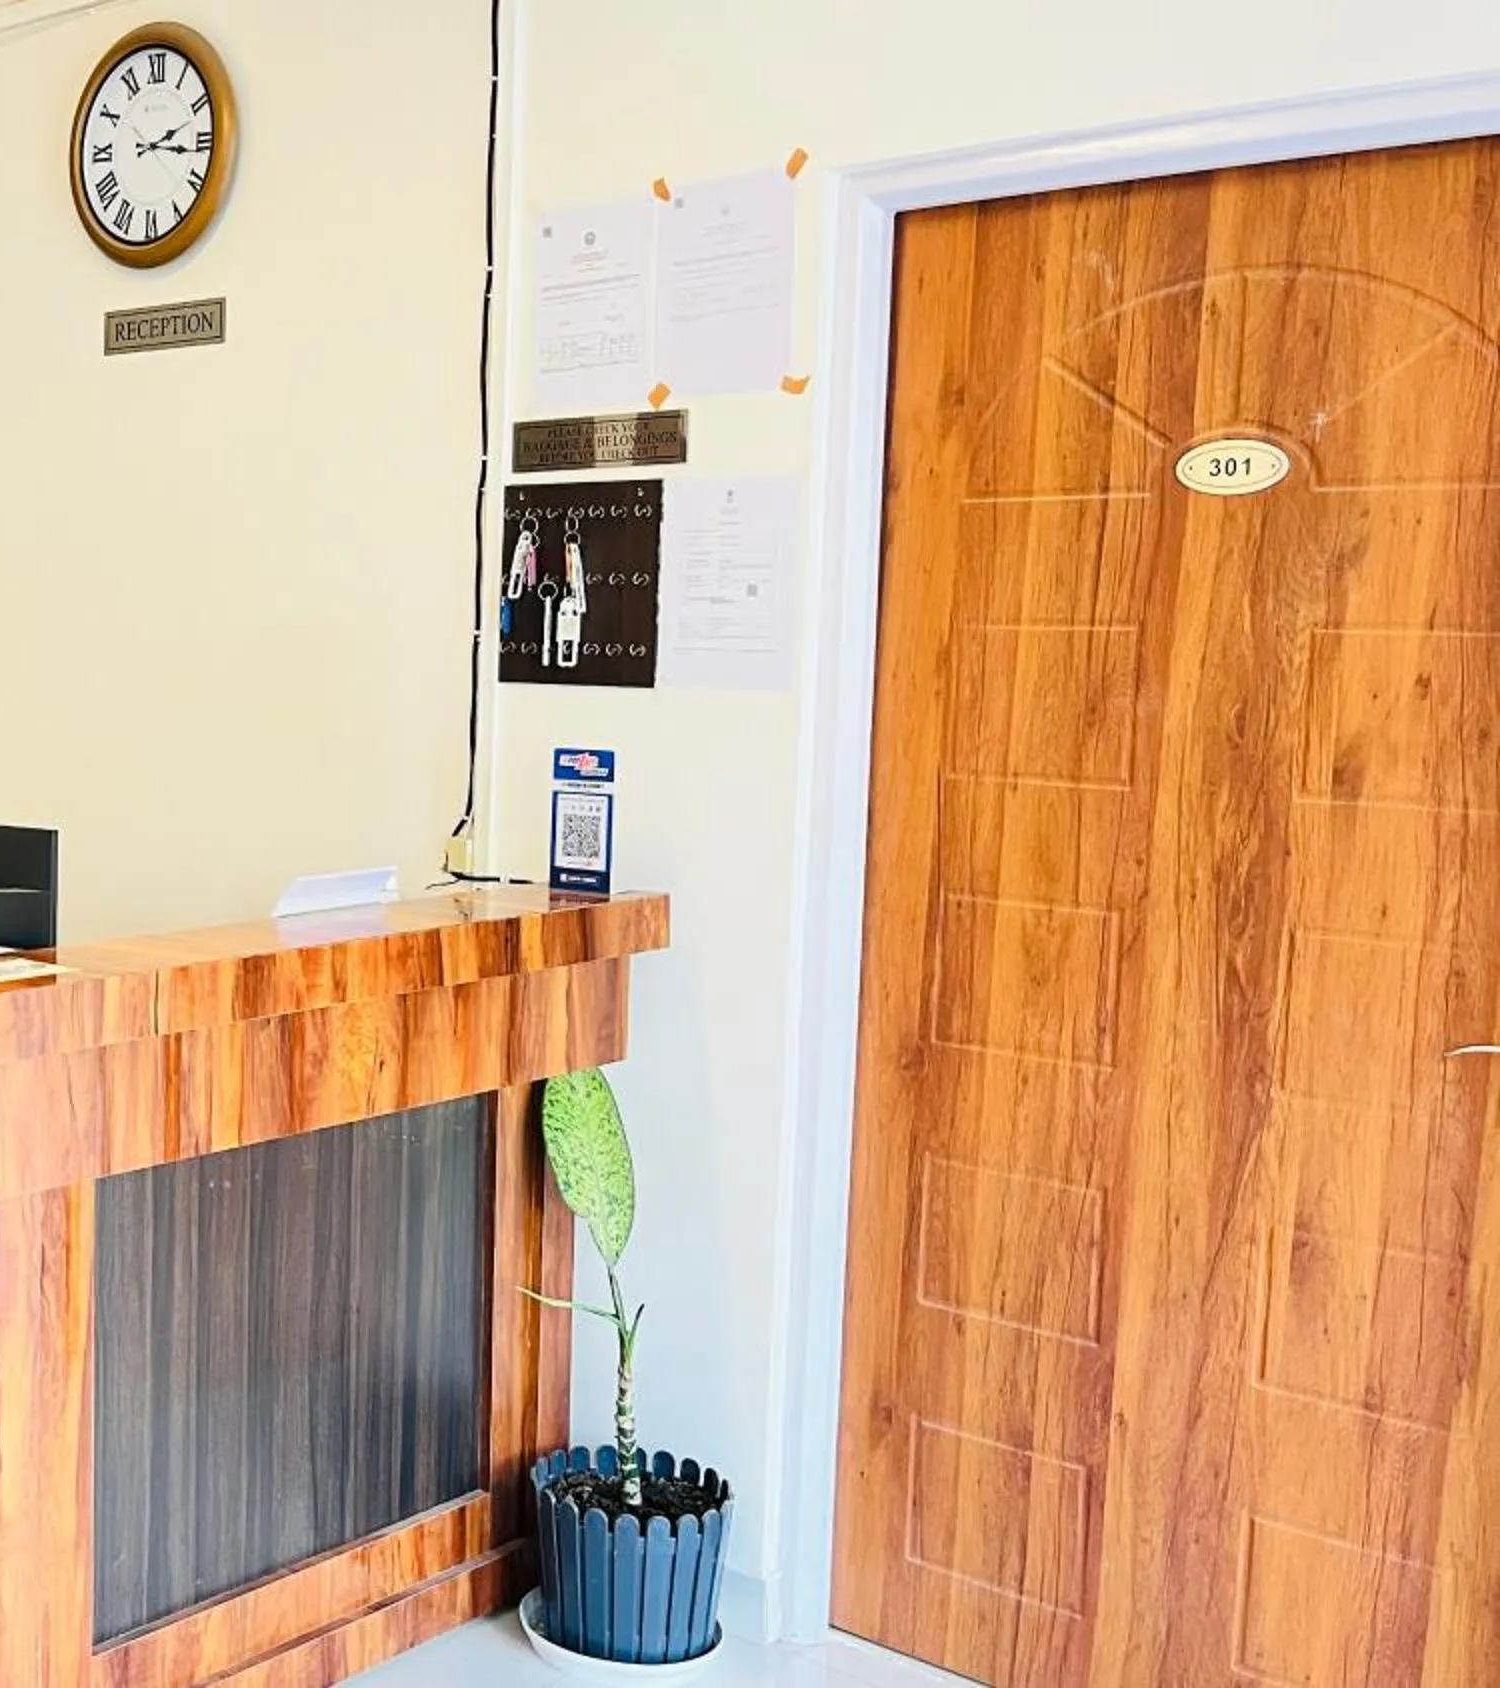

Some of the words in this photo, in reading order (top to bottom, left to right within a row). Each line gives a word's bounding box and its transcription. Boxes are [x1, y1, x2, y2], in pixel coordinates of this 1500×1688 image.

[148, 53, 166, 84] XII
[120, 67, 141, 100] XI
[100, 103, 121, 127] X
[190, 93, 209, 116] II
[92, 143, 112, 163] IX
[196, 132, 212, 152] III
[113, 199, 135, 235] VII
[145, 210, 159, 240] VI
[115, 312, 213, 342] RECEPTION
[548, 425, 581, 438] PLEASE
[585, 422, 618, 435] CHECK
[621, 421, 650, 433] YOUR
[597, 431, 677, 448] BELONGINGS
[1208, 457, 1251, 477] 301
